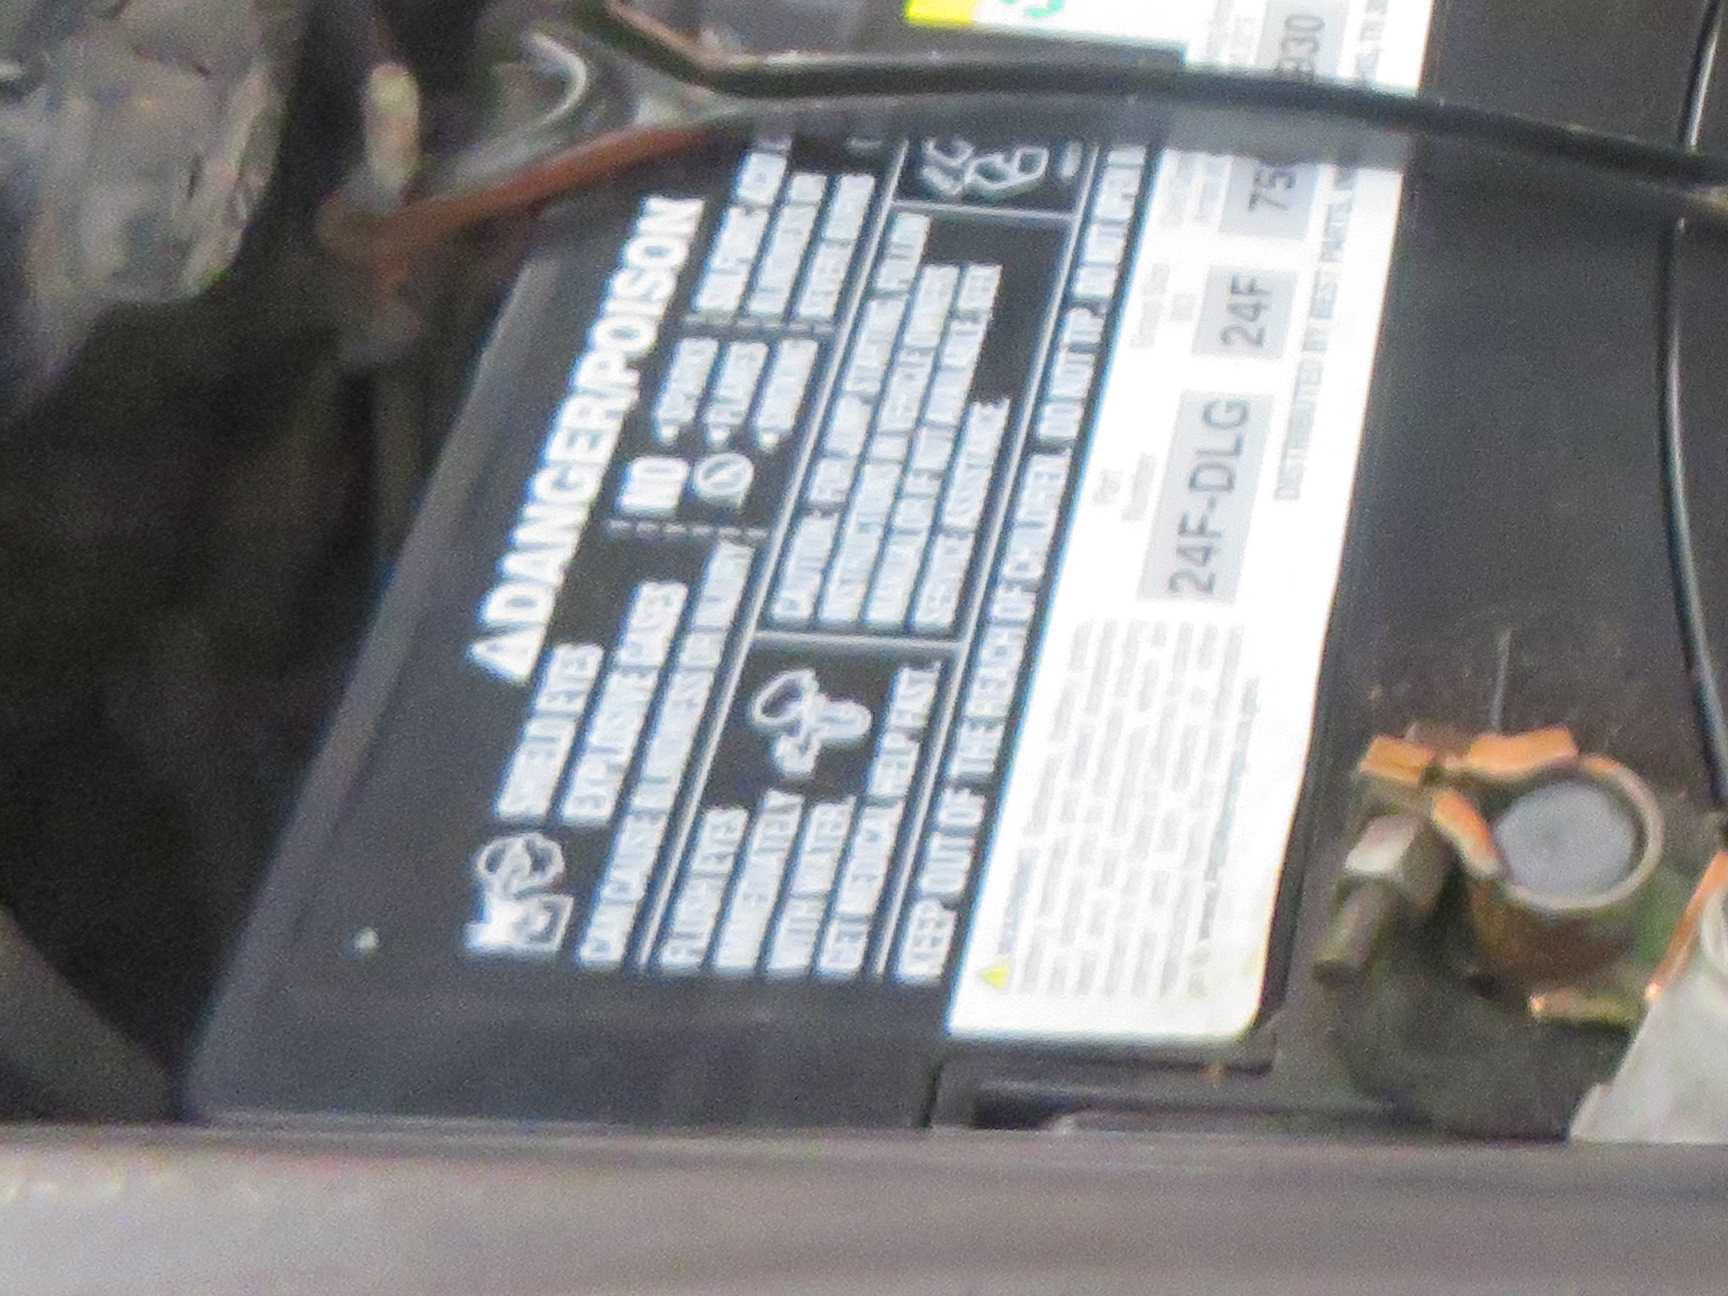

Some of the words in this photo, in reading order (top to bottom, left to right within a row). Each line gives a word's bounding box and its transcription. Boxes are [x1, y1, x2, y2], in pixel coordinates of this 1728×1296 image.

[1246, 159, 1298, 214] 75
[1216, 272, 1277, 349] 24F
[618, 457, 691, 508] NO
[1163, 398, 1252, 594] 24F-DLG
[534, 645, 606, 711] EYES
[494, 719, 579, 816] SHIELD
[561, 672, 657, 817] EXPLOSIVE
[949, 720, 1004, 774] THE
[935, 790, 987, 824] OF
[920, 832, 977, 891] OUT
[899, 901, 959, 975] KEEP
